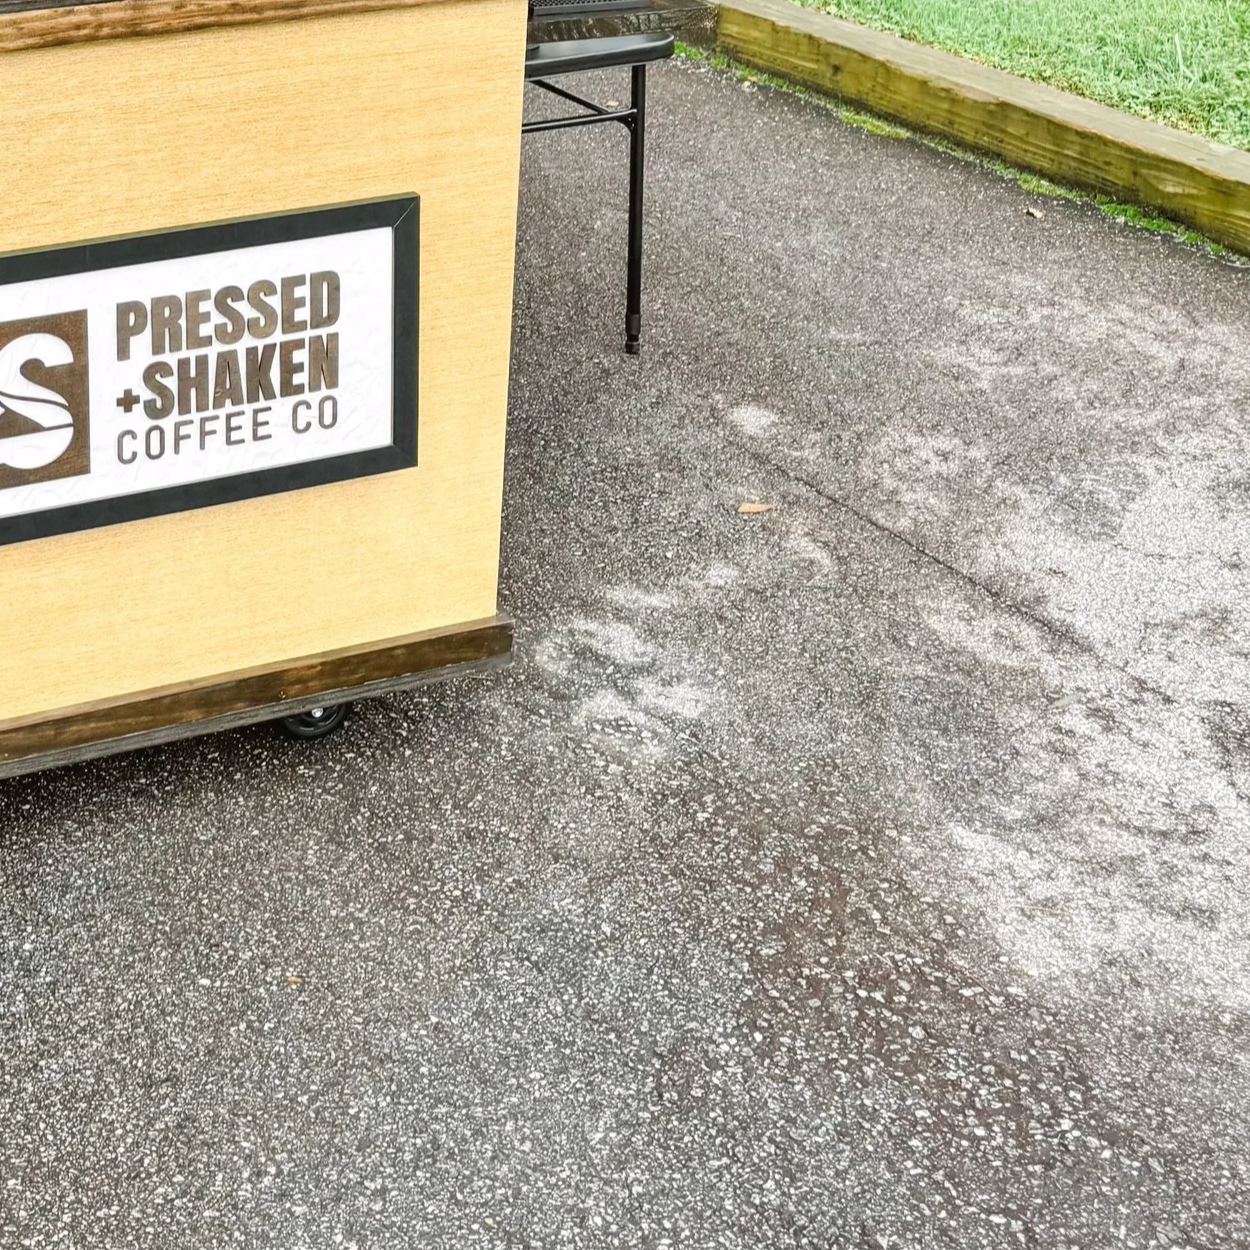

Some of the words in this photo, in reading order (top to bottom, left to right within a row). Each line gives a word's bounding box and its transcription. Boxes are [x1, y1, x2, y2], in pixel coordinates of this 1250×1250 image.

[116, 270, 341, 361] PRESSED
[117, 405, 273, 465] COFFEE
[292, 395, 339, 435] CO
